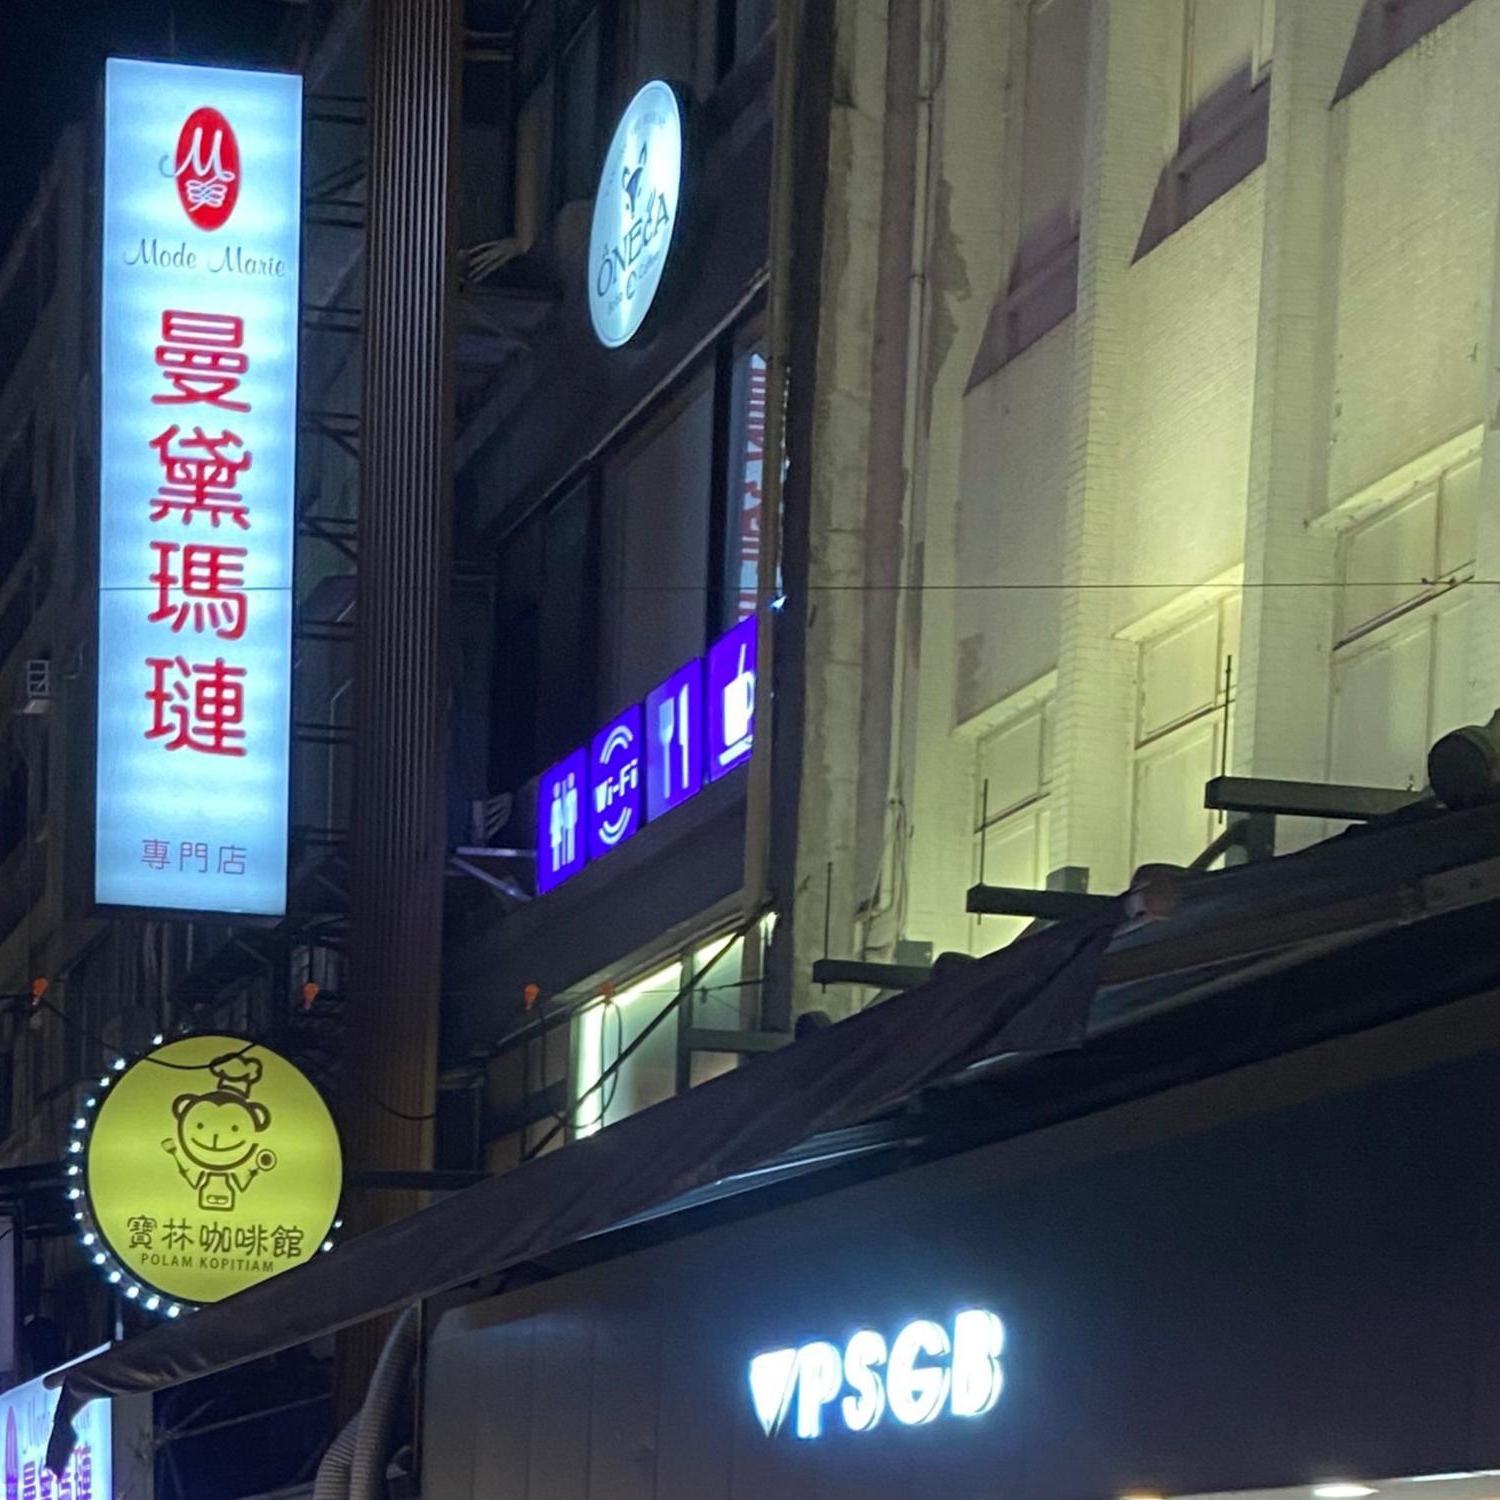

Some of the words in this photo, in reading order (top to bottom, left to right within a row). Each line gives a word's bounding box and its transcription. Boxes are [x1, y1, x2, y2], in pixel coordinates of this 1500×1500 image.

[123, 238, 197, 270] Mode
[208, 246, 285, 278] Marie
[145, 310, 252, 760] 曼黛瑪璉
[595, 758, 639, 813] Wi-Fi
[140, 838, 248, 875] 專門店
[127, 1214, 305, 1260] 寶林咖啡館
[141, 1252, 193, 1268] POLAM
[199, 1256, 275, 1273] KOPITIAM
